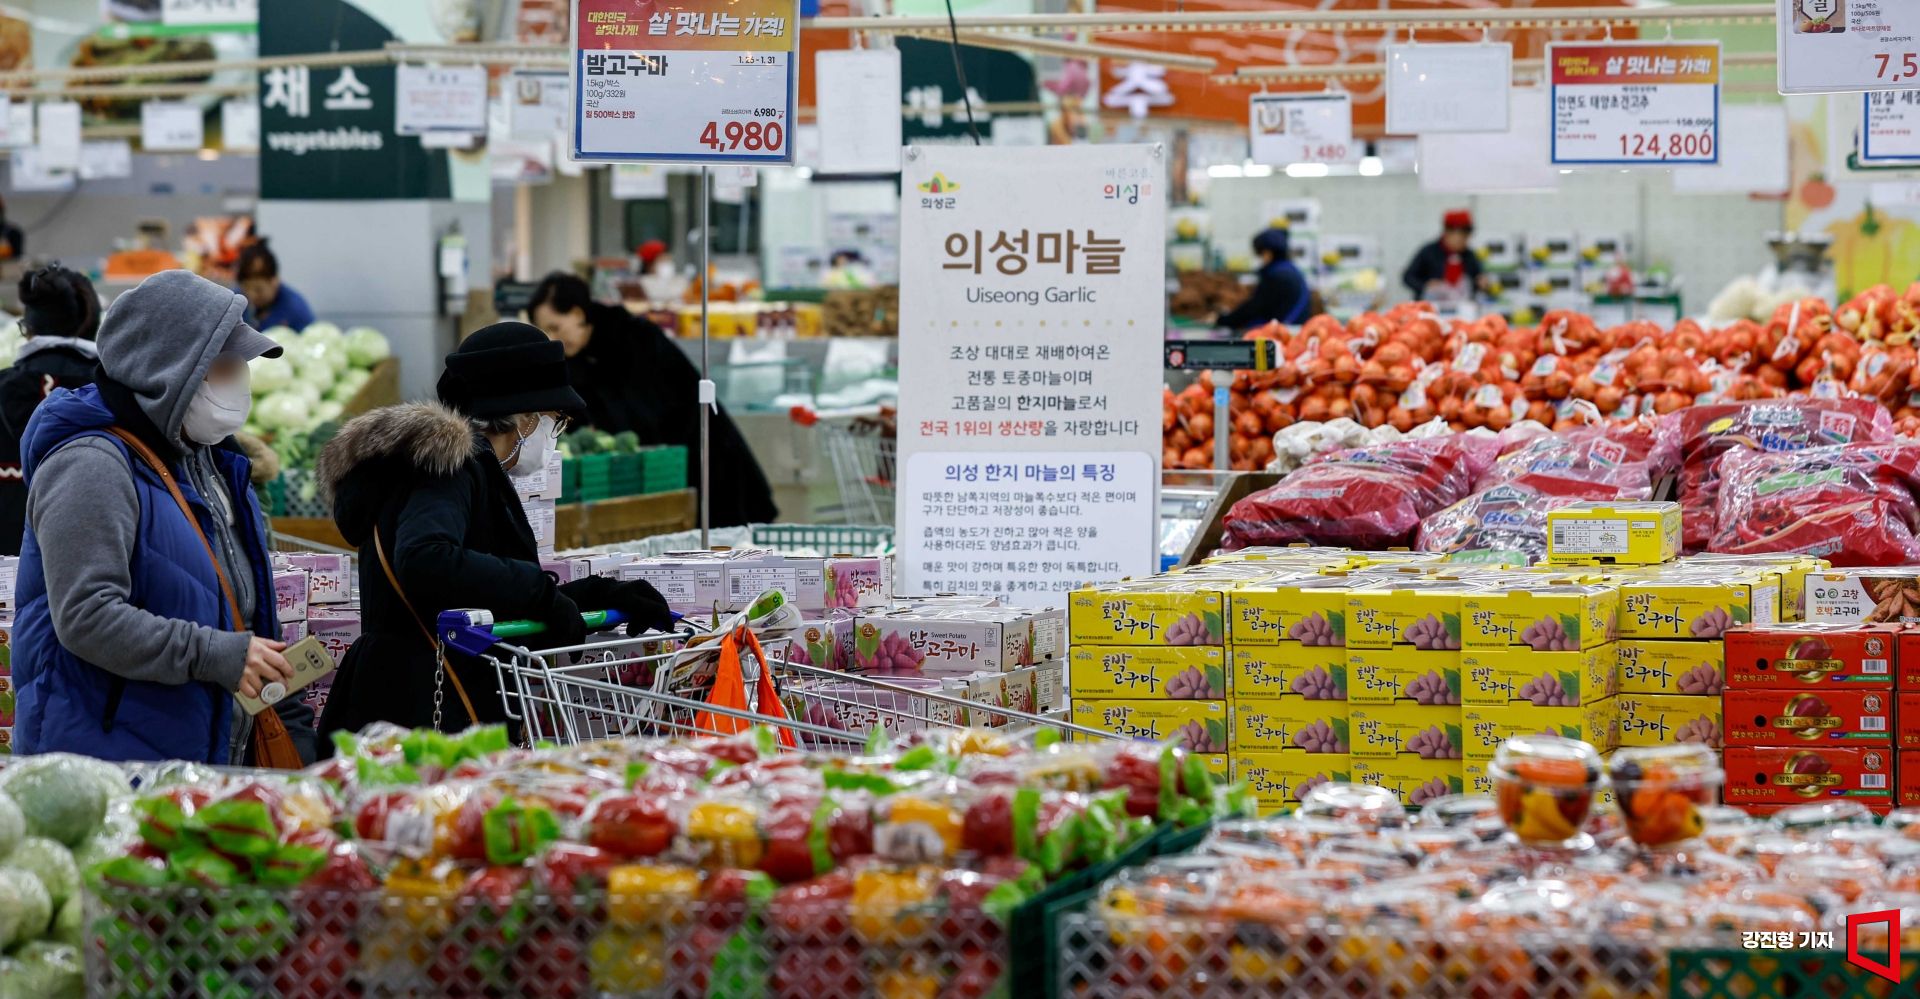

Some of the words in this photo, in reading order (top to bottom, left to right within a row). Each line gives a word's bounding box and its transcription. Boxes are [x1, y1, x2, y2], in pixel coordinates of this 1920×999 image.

[587, 11, 627, 23] 대한민국
[648, 11, 672, 36] 살
[675, 11, 740, 36] 맛나는
[744, 15, 786, 37] 가격!
[586, 54, 668, 76] 밤고구마
[586, 90, 626, 99] 100g/332원
[586, 100, 600, 108] 국산
[594, 110, 621, 119] 500박스
[622, 111, 636, 119] 한정
[754, 108, 776, 117] 6,980
[266, 126, 383, 155] vegetables
[700, 121, 783, 152] 4,980
[1620, 134, 1712, 160] 124,800
[922, 198, 956, 210] 의성군
[942, 229, 1126, 276] 의성마늘
[966, 287, 1039, 306] Uiseong
[1044, 286, 1096, 303] Garlic
[950, 345, 979, 360] 조상
[985, 345, 1030, 360] 대대로
[1036, 345, 1111, 360] 재배하여온
[968, 370, 996, 386] 전통
[1002, 370, 1092, 386] 토종마늘이며
[951, 396, 1012, 411] 고품질의
[1016, 396, 1107, 411] 한지마늘로서
[920, 420, 949, 436] 전국
[954, 420, 992, 436] 1위의
[998, 420, 1058, 436] 생산량을
[1063, 420, 1140, 436] 자랑합니다
[945, 464, 979, 482] 의성
[985, 464, 1018, 482] 한지
[1024, 464, 1076, 482] 마늘의
[1082, 464, 1116, 482] 특징
[922, 491, 954, 503] 따뜻한
[957, 491, 1010, 503] 남쪽지역의
[1081, 491, 1100, 503] 적은
[922, 505, 943, 516] 구가
[946, 505, 988, 516] 단단하고
[992, 505, 1034, 516] 저장성이
[1038, 505, 1082, 516] 좋습니다.
[958, 526, 990, 538] 농도가
[1053, 526, 1073, 538] 적은
[923, 540, 986, 551] 사용하더라도
[922, 561, 943, 573] 매운
[948, 561, 967, 573] 맛이
[972, 561, 1003, 573] 강하며
[1007, 561, 1038, 573] 특유한
[1066, 561, 1122, 573] 독특합니다.
[312, 575, 340, 593] 고구마
[858, 577, 883, 595] 고구마
[922, 581, 943, 592] 특히
[947, 581, 978, 592] 김치의
[982, 581, 1002, 592] 맛을
[276, 593, 297, 612] 구마
[1626, 594, 1656, 613] 호박
[1842, 589, 1859, 599] 고창
[1102, 600, 1133, 619] 호박
[1816, 606, 1860, 616] 호박고구마
[1114, 613, 1160, 640] 고구마
[1251, 616, 1285, 637] 고구마
[1365, 619, 1399, 639] 고구마
[1638, 606, 1684, 634] 고구마
[909, 630, 929, 648] 밤
[1482, 621, 1517, 641] 고구마
[926, 641, 980, 661] 고구마
[1102, 653, 1133, 673] 호박
[1114, 666, 1160, 693] 고구마
[1253, 670, 1287, 690] 고구마
[1625, 661, 1672, 688] 고구마
[1366, 675, 1401, 695] 고구마
[1480, 677, 1516, 698] 고구마
[1103, 706, 1134, 726] 호박
[1255, 724, 1289, 744] 고구마
[1623, 714, 1670, 741] 고구마
[1368, 730, 1402, 750] 고구마
[1255, 777, 1290, 798] 고구마
